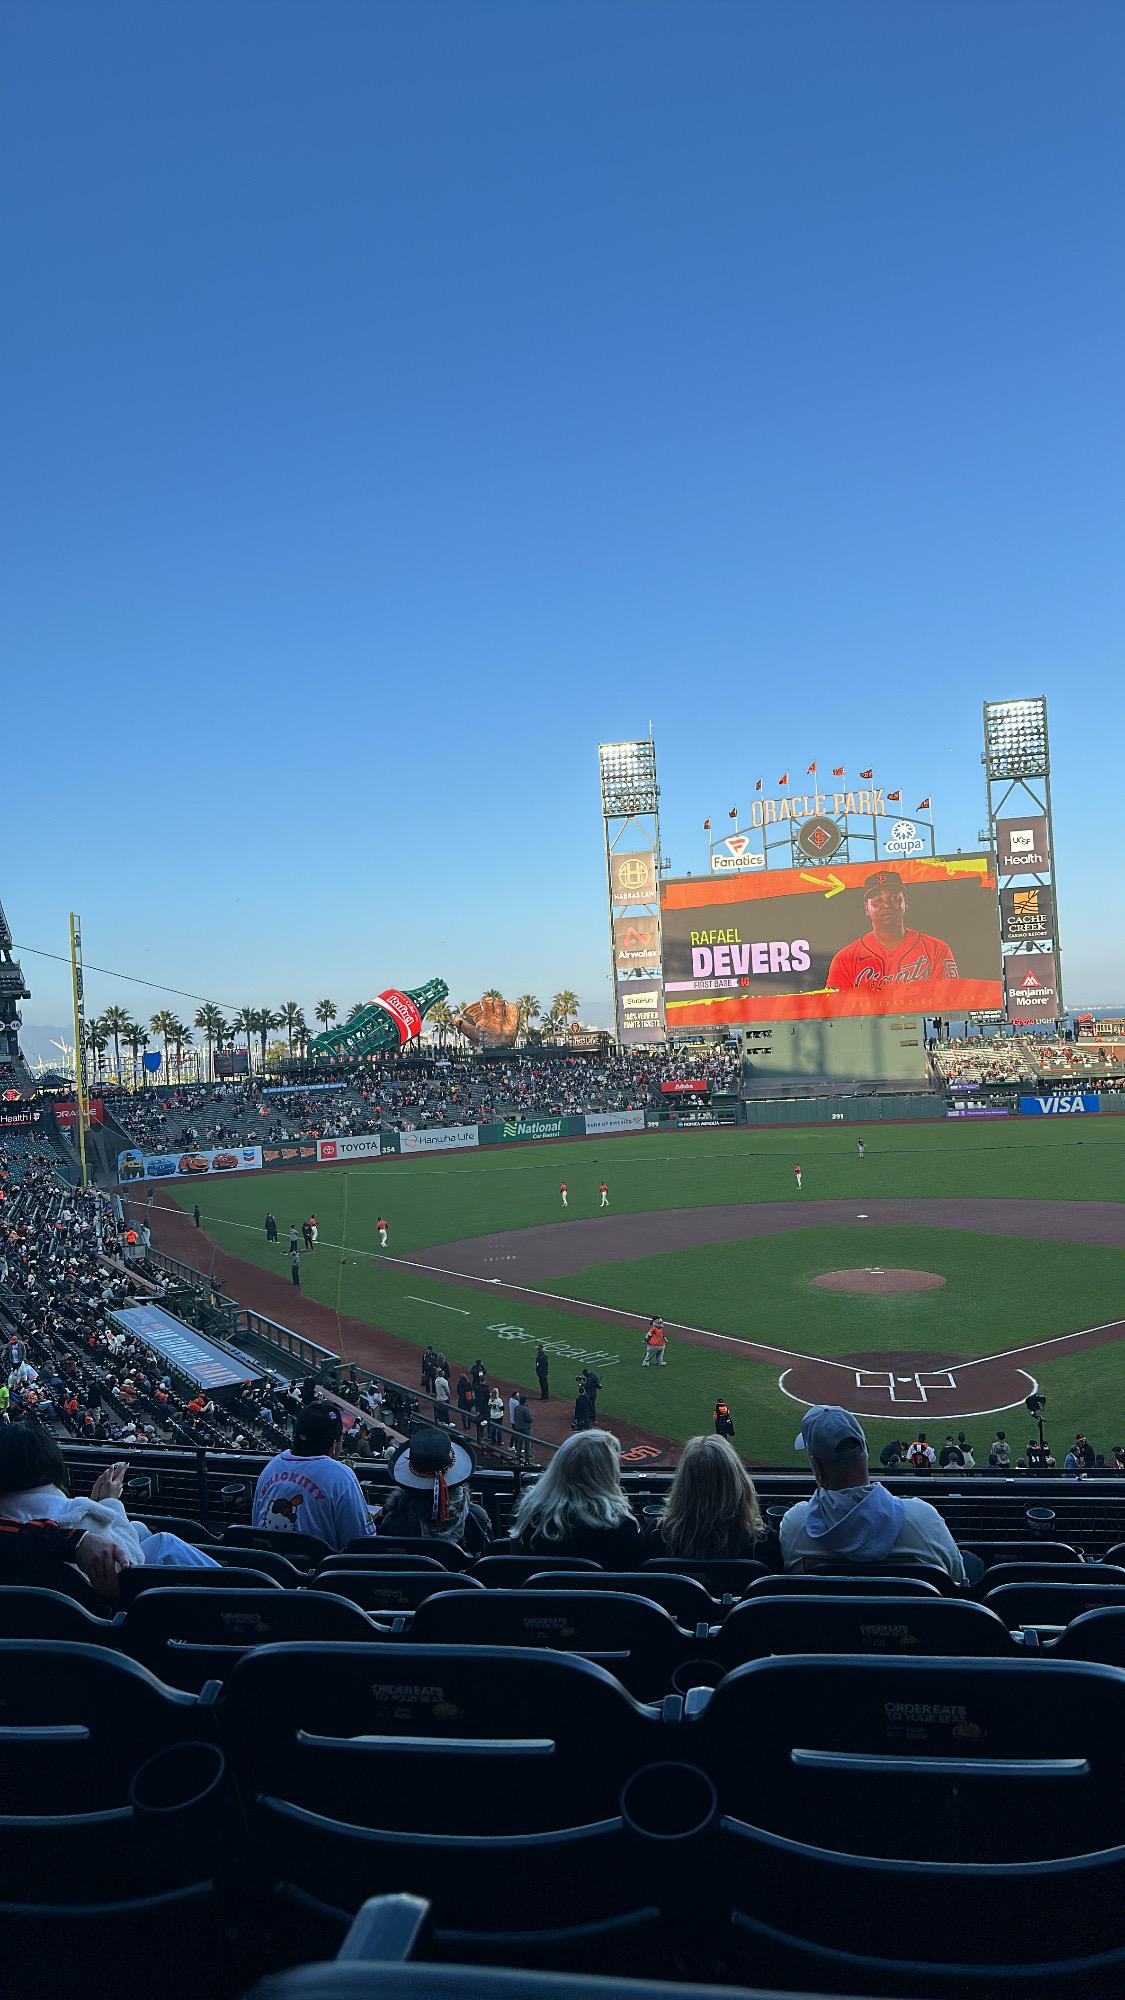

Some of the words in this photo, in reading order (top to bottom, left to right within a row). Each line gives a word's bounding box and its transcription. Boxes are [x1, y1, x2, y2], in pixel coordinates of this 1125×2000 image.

[752, 794, 826, 827] ORACLE
[832, 788, 887, 816] PARK
[888, 840, 922, 852] coupa
[1012, 836, 1031, 846] UCSF
[714, 856, 763, 868] Fanatics
[1004, 853, 1043, 866] Health
[1007, 914, 1047, 925] CACHE
[1008, 923, 1046, 932] CREEK
[690, 928, 742, 946] RAFAEL
[691, 939, 811, 978] DEVERS
[694, 980, 712, 989] FIRST
[714, 979, 732, 988] BASE
[1009, 987, 1054, 999] Benjamin
[1016, 997, 1047, 1006] Moore
[1034, 1097, 1085, 1114] VISA
[0, 1113, 28, 1123] Health
[518, 1120, 562, 1134] National
[419, 1134, 456, 1145] Hanwha
[458, 1132, 475, 1141] Life
[340, 1141, 378, 1152] TOYOTA
